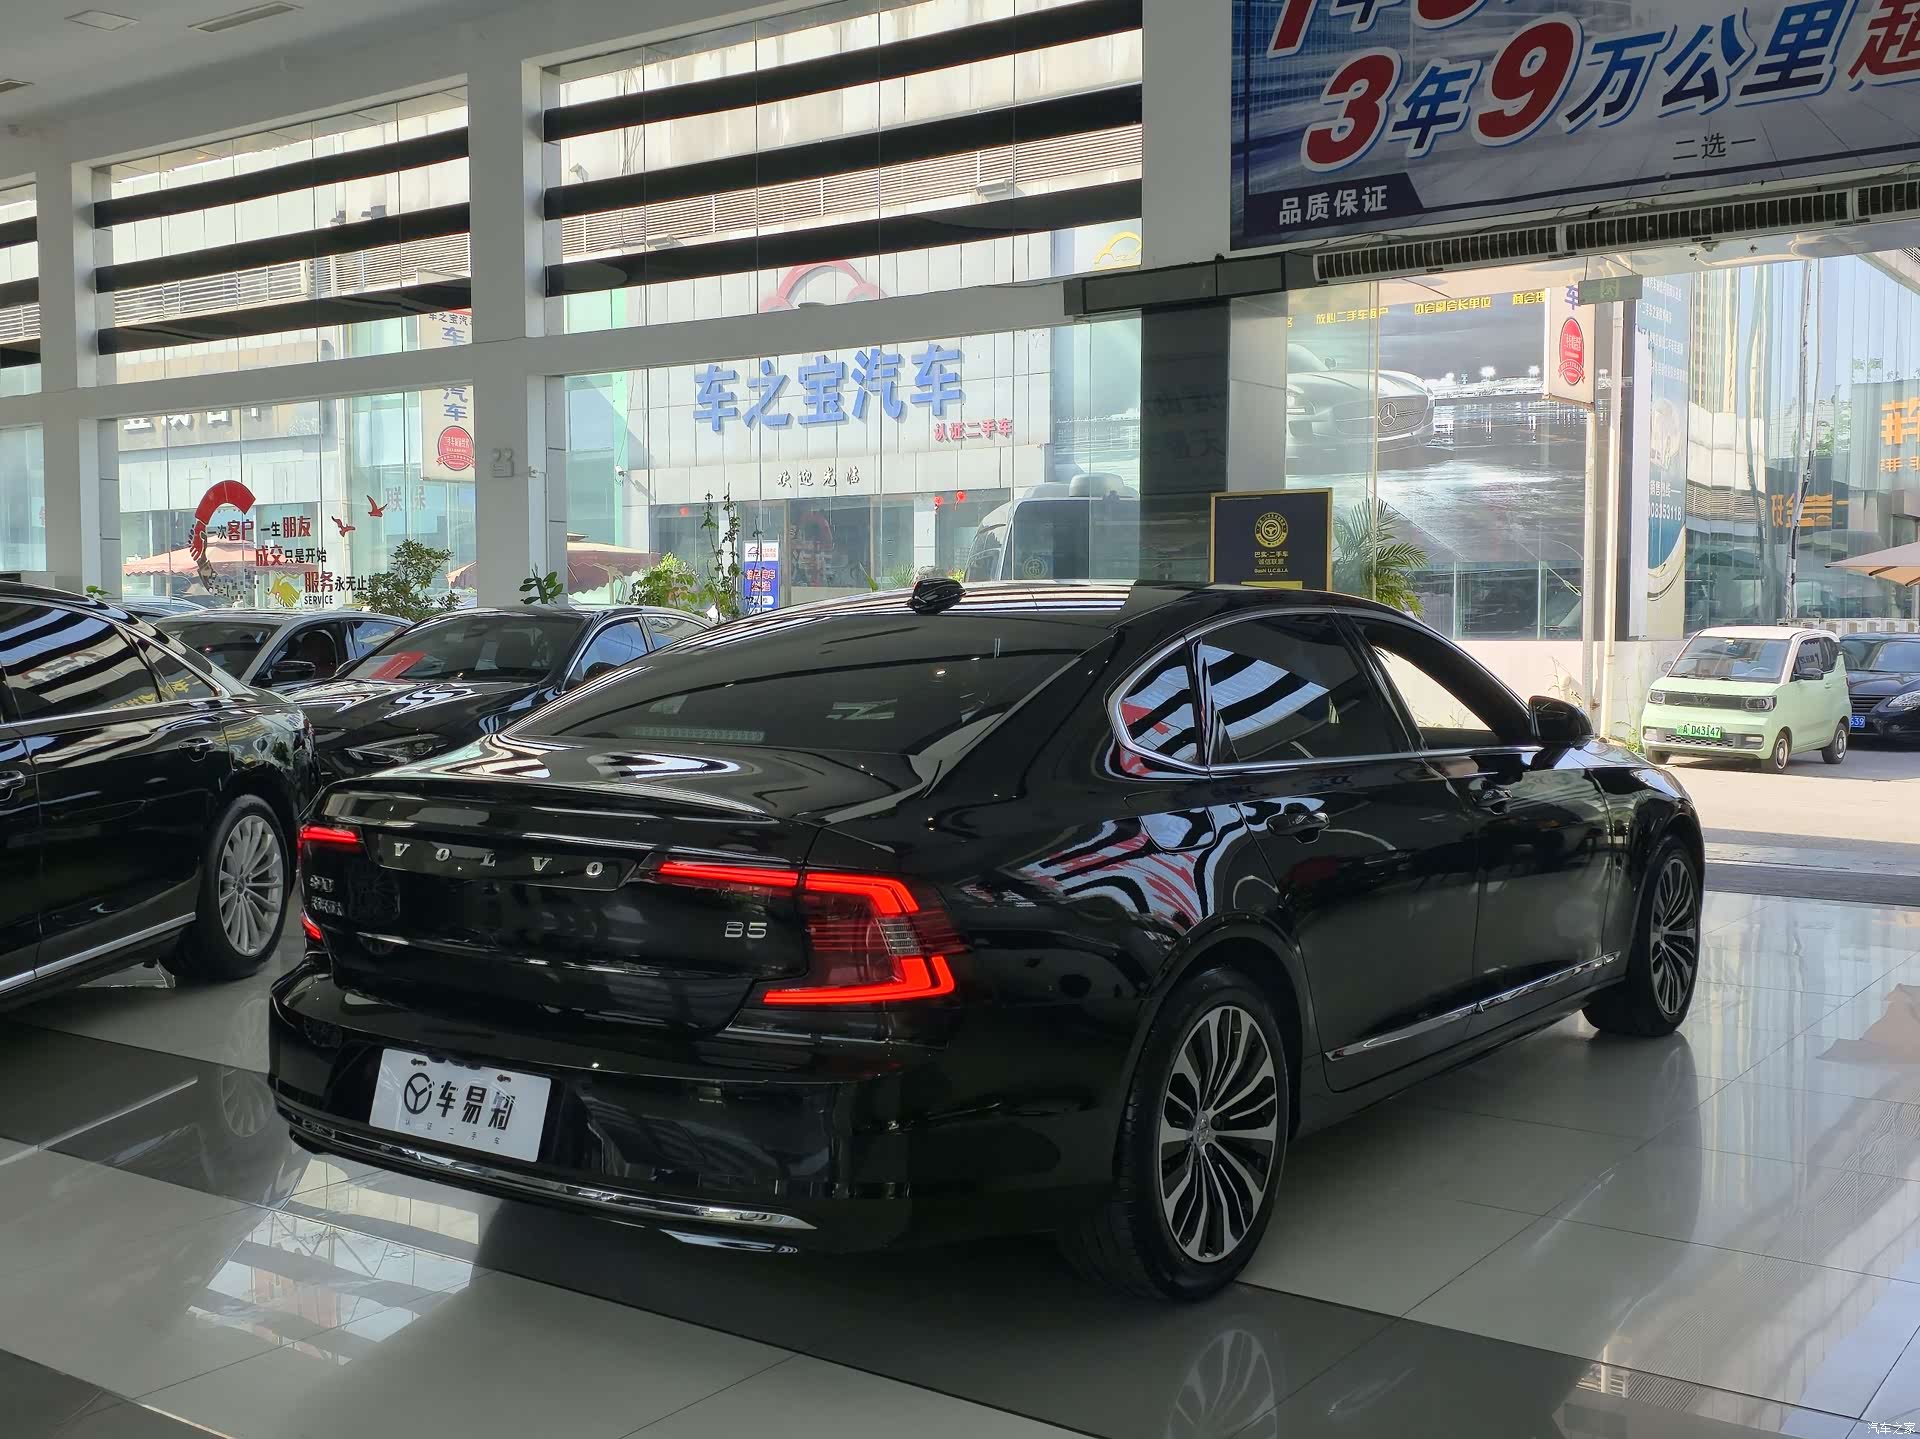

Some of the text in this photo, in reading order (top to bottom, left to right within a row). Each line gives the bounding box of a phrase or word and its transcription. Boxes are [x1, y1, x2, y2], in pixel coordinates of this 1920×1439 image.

[1672, 133, 1758, 162] 二选一
[1279, 184, 1388, 225] 品质保证
[429, 313, 472, 326] 车之宝汽
[693, 344, 963, 432] 车之宝汽车
[933, 419, 1013, 442] 认证二手车
[776, 466, 860, 488] 欢迎光临
[260, 515, 311, 538] 一生朋友
[255, 544, 327, 567] 成交只是开始
[304, 595, 333, 605] SERVCE
[394, 842, 605, 877] VOLVO
[724, 921, 768, 939] B5
